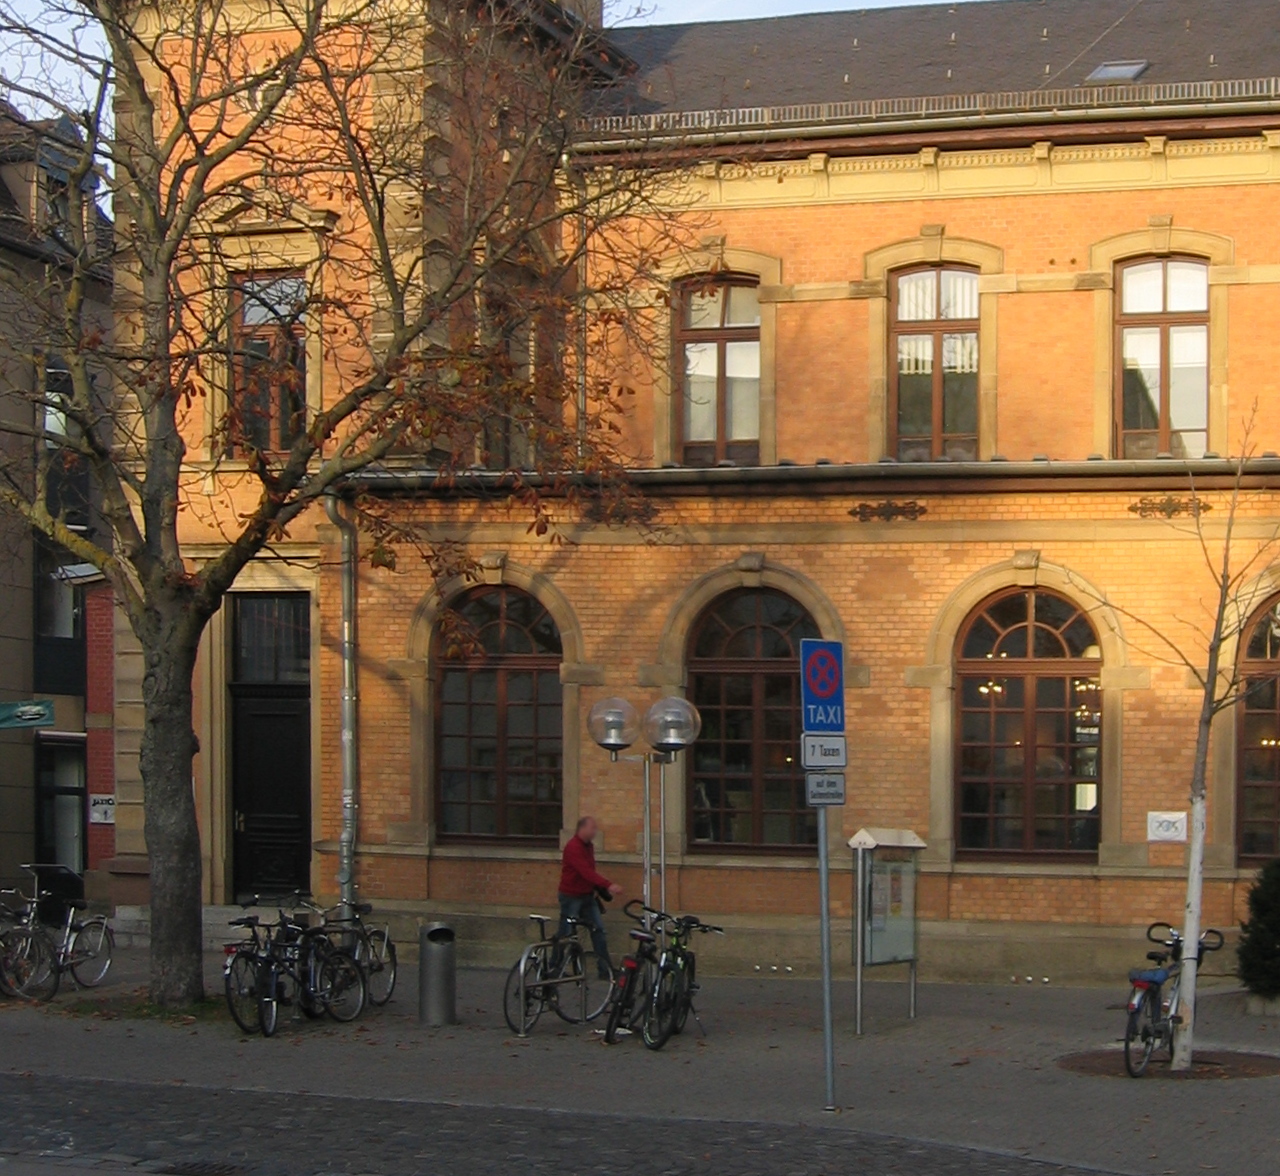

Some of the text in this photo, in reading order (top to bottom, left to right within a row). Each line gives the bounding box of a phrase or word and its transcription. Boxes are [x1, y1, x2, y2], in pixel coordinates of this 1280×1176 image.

[807, 705, 841, 724] TAXI
[811, 744, 840, 757] 7 Taxen
